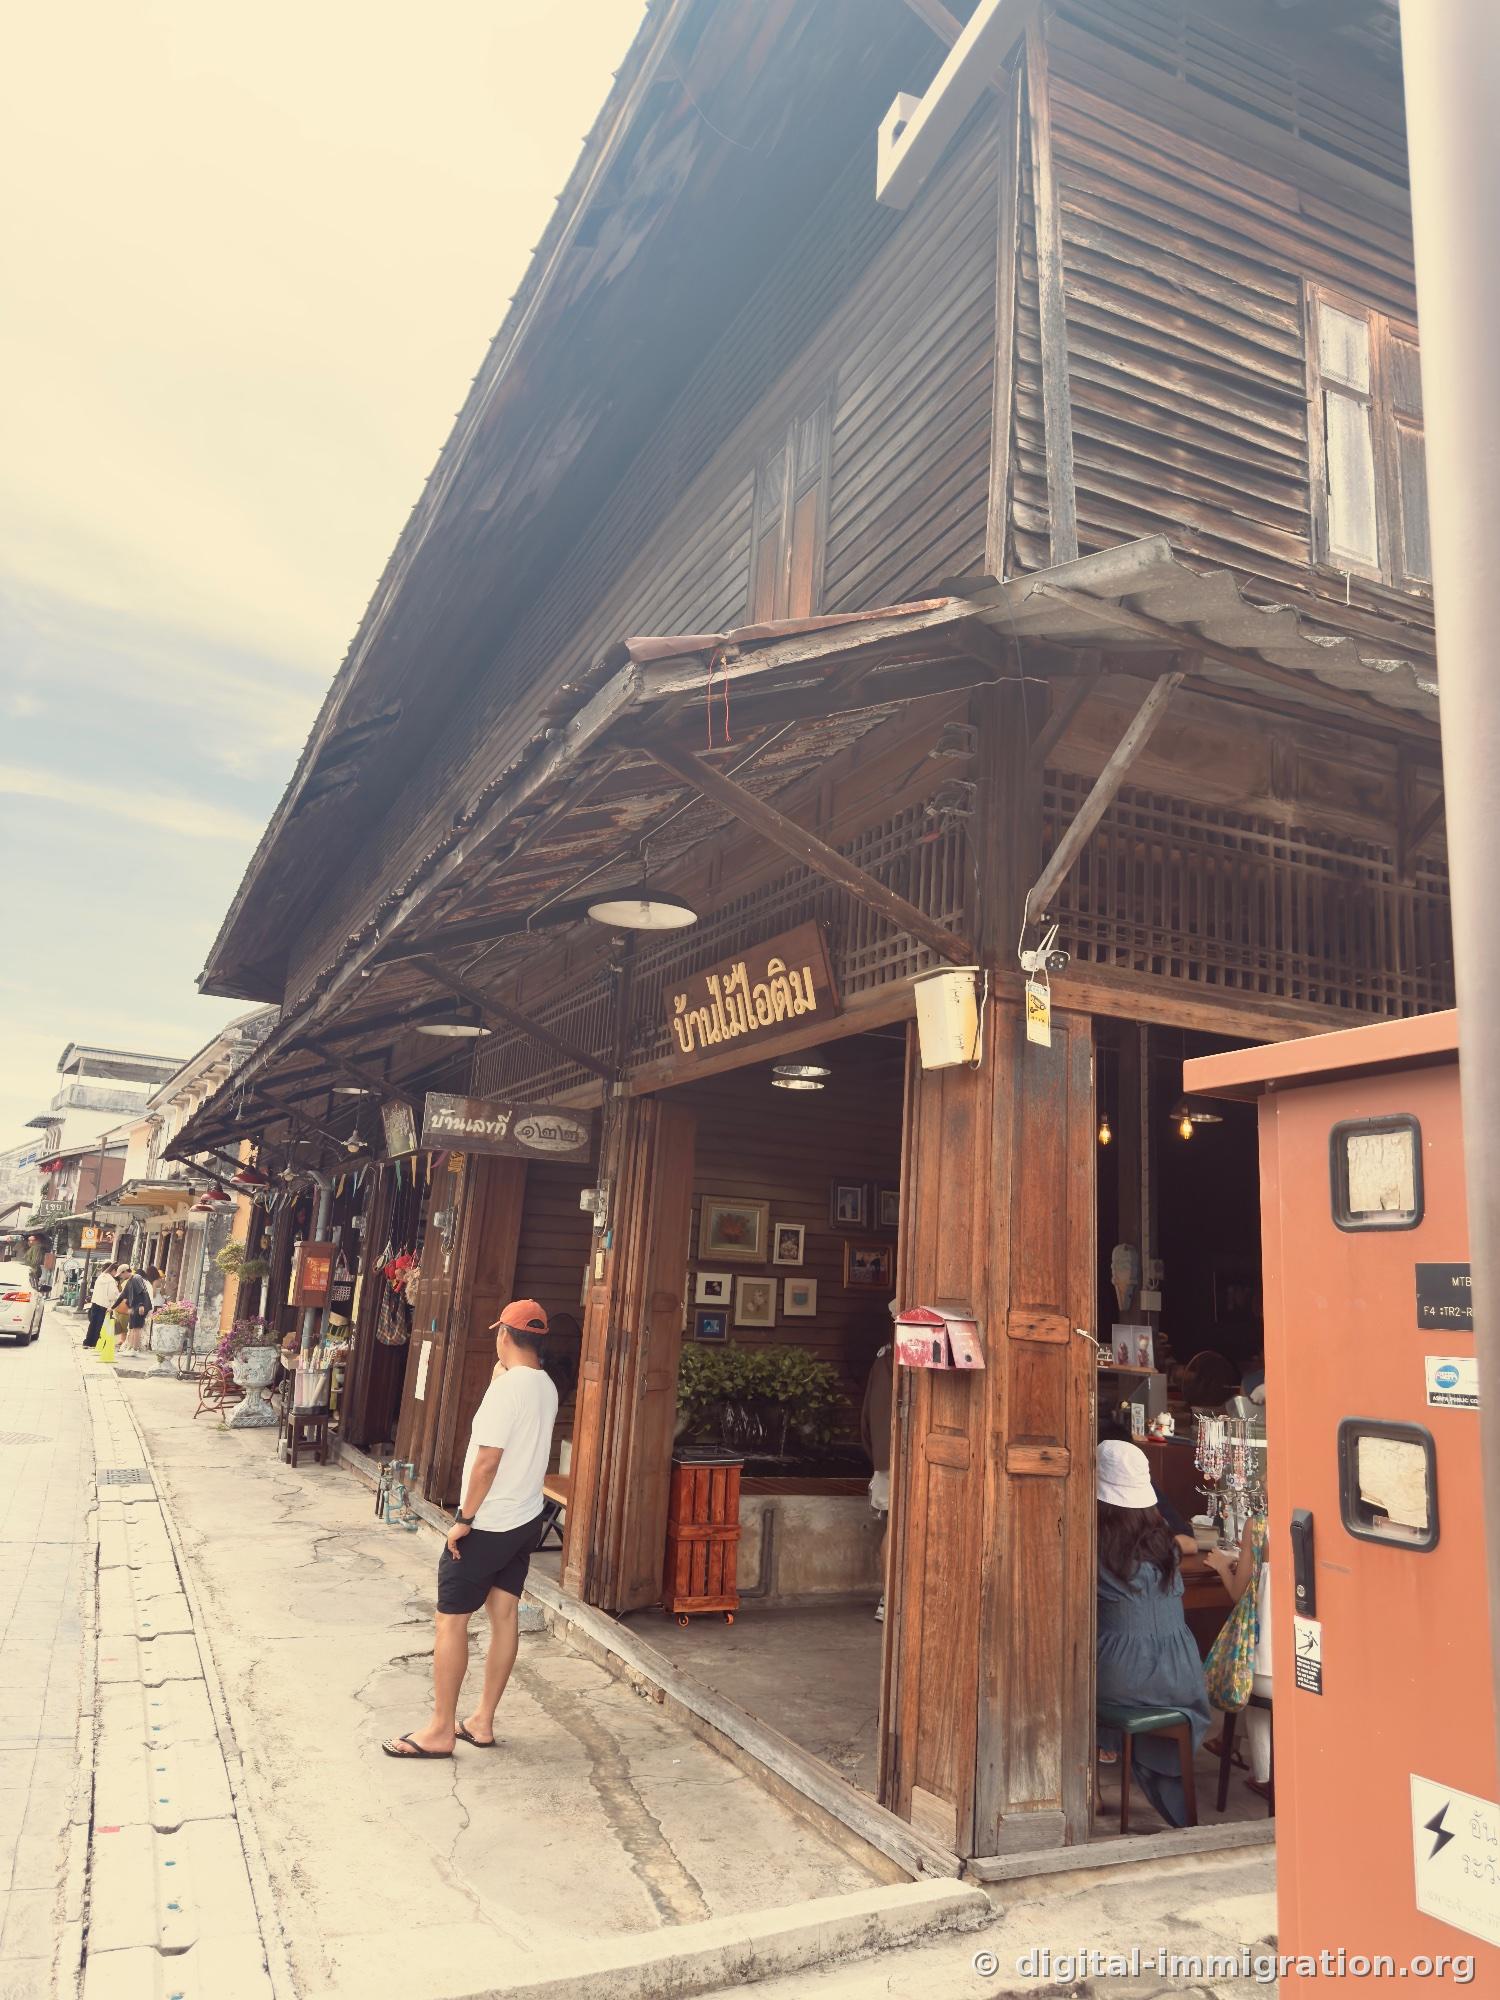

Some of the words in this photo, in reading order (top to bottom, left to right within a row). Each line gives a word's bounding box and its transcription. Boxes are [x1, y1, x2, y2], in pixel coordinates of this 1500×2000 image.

[673, 957, 817, 1053] บ้านไม้ไอติม
